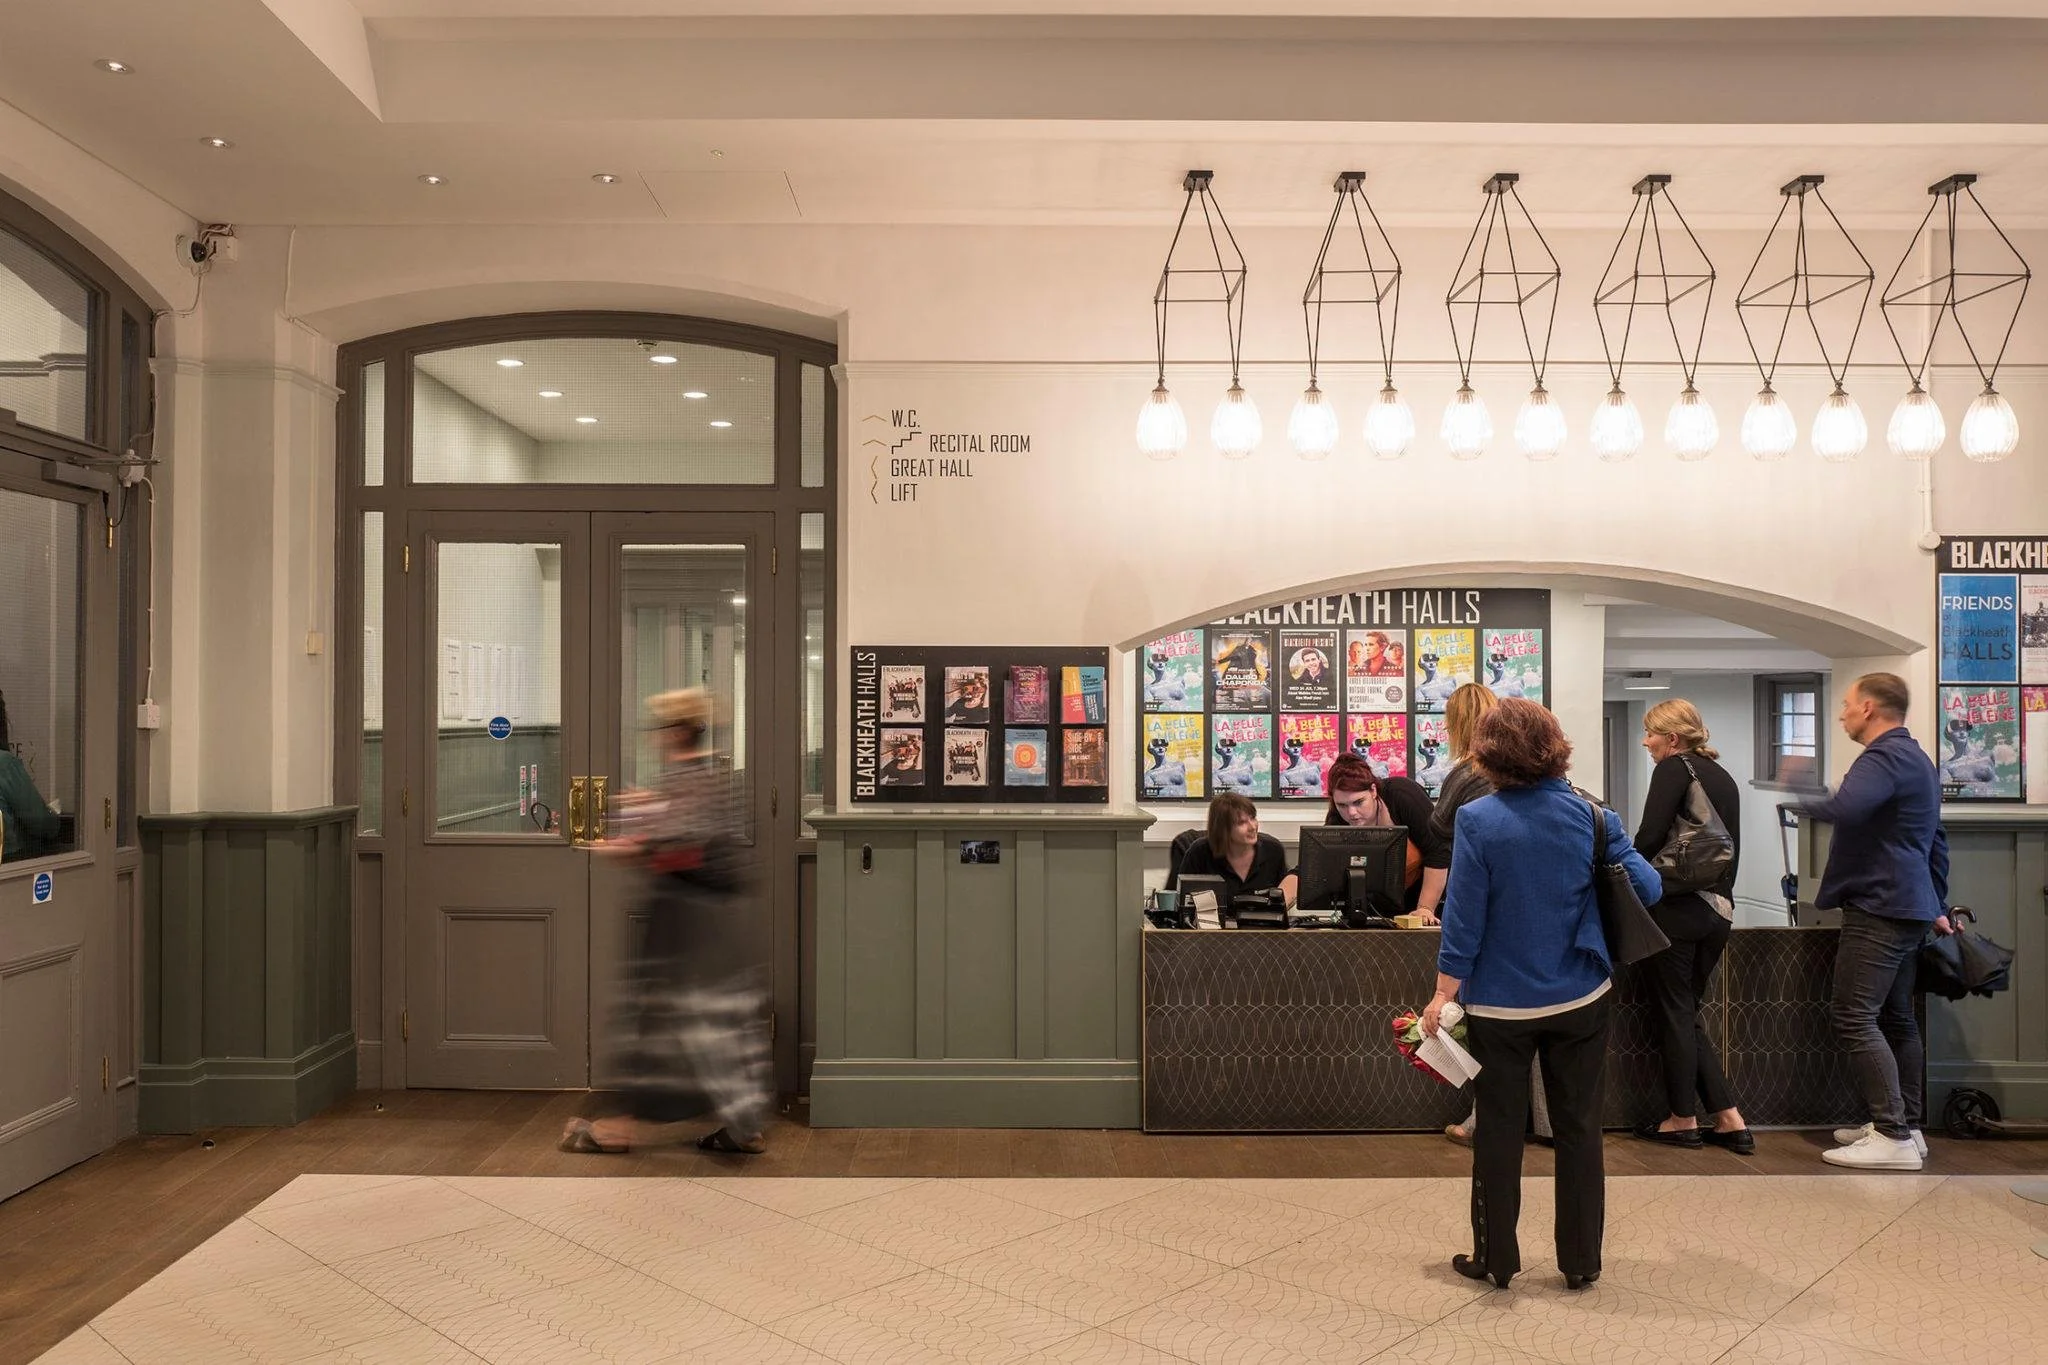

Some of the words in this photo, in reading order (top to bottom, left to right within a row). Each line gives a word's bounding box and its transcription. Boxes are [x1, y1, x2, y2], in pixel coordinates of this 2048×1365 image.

[891, 410, 920, 428] W.C.
[930, 434, 985, 453] RECITAL
[990, 434, 1030, 453] ROOM
[891, 459, 934, 477] GREAT
[940, 459, 973, 477] HALL
[891, 483, 918, 501] LIFT
[1402, 591, 1480, 625] HALLS
[1942, 595, 2013, 610] FRIENDS
[1943, 642, 2013, 660] HALLS
[857, 652, 876, 695] HALLS
[1943, 695, 1964, 711] LA
[2024, 696, 2046, 711] LA
[857, 700, 876, 796] BLACKHEATH
